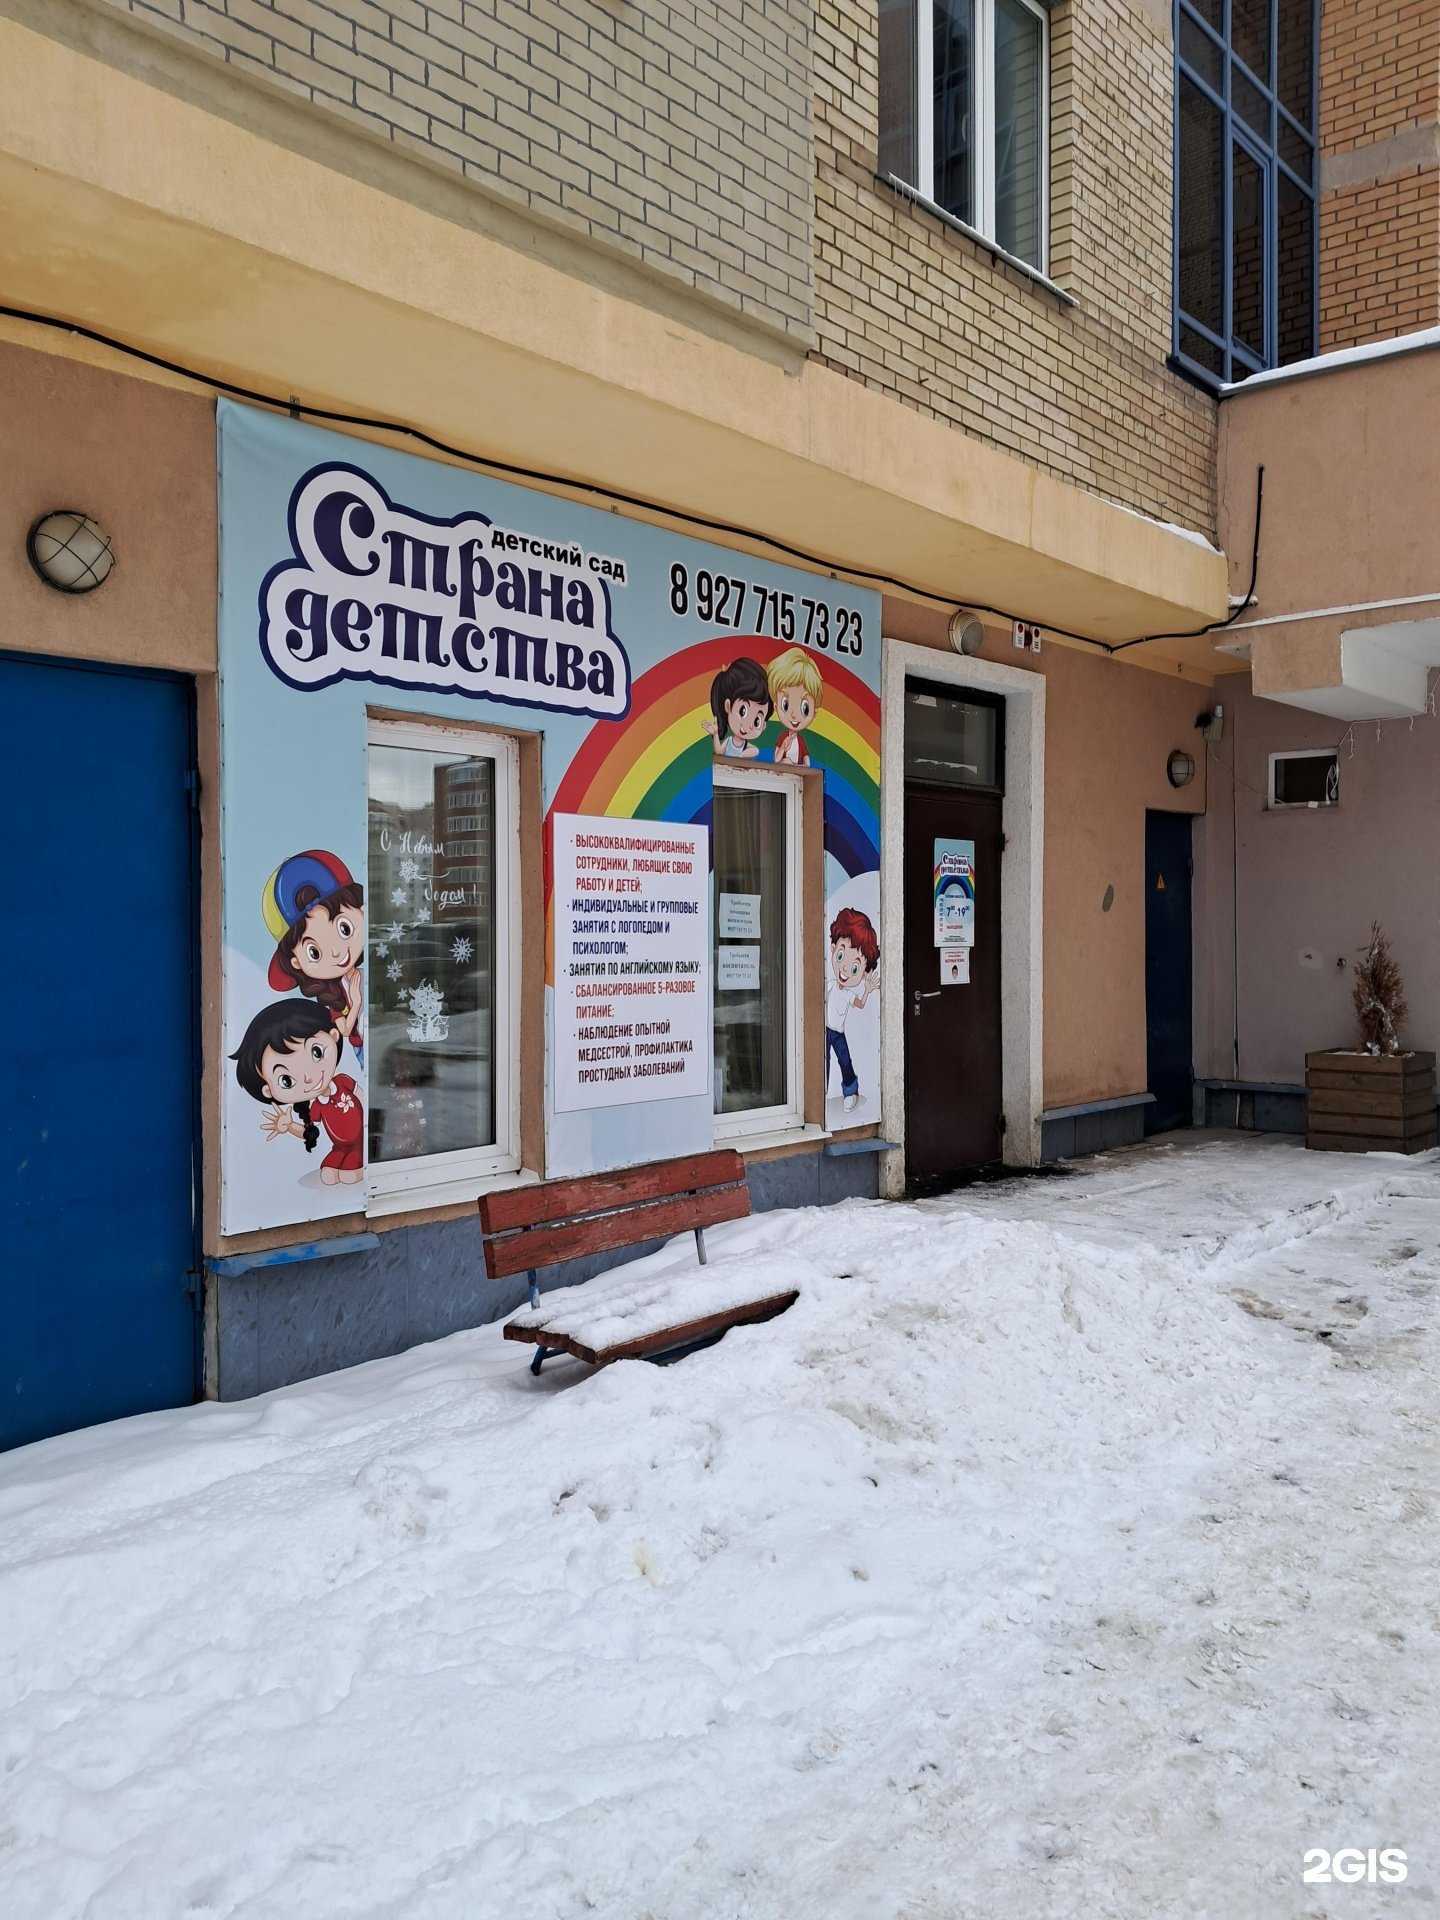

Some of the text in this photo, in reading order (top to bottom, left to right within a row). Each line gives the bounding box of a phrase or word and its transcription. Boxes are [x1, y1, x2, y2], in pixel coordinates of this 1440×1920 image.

[313, 491, 594, 628] Страна
[491, 530, 625, 582] детский сад
[671, 563, 862, 656] 8 927 715 73 23
[285, 588, 615, 697] детства
[575, 834, 696, 855] ВЫСОКОКВАЛИФИЦИРОВАННЫЕ
[576, 856, 693, 874] СОТРУДНИКИ, ЛЮБЯЩИЕ СВОЮ
[576, 877, 643, 893] РАБОТУ И ДЕТЕЙ;
[572, 899, 699, 914] ИНДИВИДУАЛЬНЫЕ И ГРУППОВЫЕ
[572, 920, 670, 934] ЗАНЯТИЯ С ЛОГОПЕДОМ И
[572, 941, 629, 955] ПСИХОЛОГОМ;
[569, 959, 701, 976] ЗАНЯТИЯ ПО АНГЛИЙСКОМУ ЯЗЫКУ;
[576, 980, 696, 998] СБАЛАНСИРОВАННОЕ 5-РАЗОВОЕ
[576, 1004, 615, 1019] ПИТАНИЕ;
[578, 1019, 671, 1040] НАБЛЮДЕНИЕ ОПЫТНОЙ
[578, 1040, 693, 1062] МЕДСЕСТРОЙ, ПРОФИЛАКТИКА
[578, 1058, 685, 1083] ПРОСТУДНЫХ ЗАБОЛЕВАНИЙ
